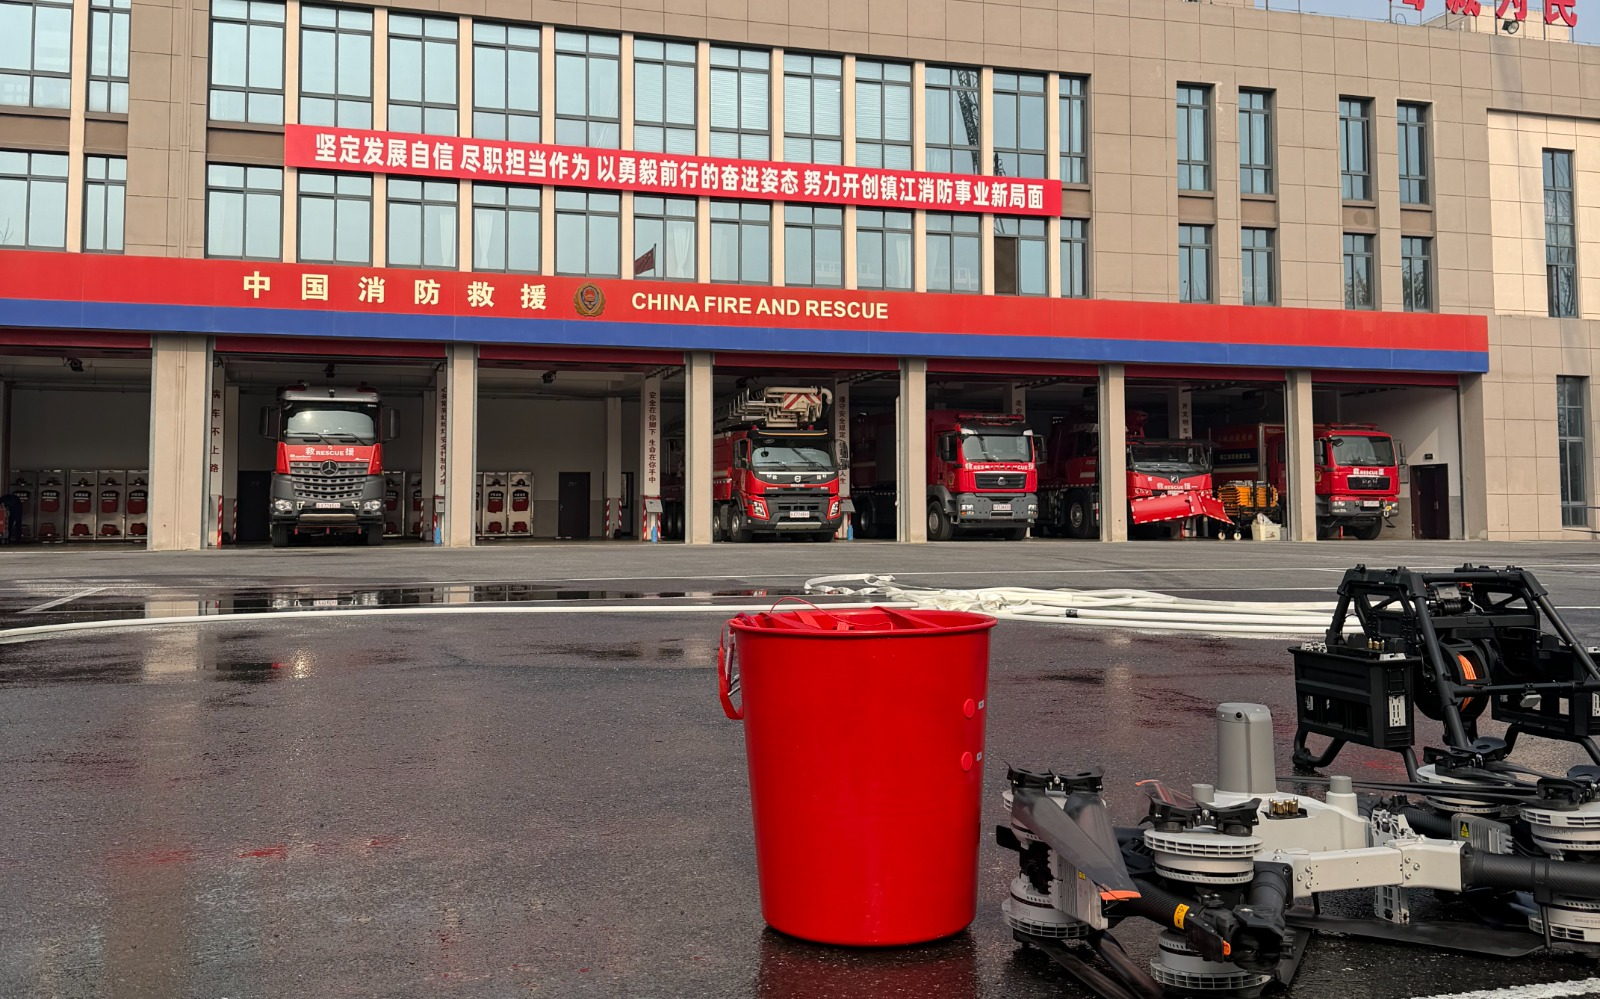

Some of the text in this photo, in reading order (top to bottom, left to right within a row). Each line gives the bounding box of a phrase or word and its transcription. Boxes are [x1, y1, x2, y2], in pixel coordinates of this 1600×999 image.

[314, 133, 1044, 210] 坚定发展自信 尽职担当作为 以勇毅前行的奋进姿态 努力开创镇江消防事业新局面
[243, 270, 547, 310] 中国消防救援
[631, 292, 889, 320] CHINA FIRE AND RESCUE
[648, 439, 657, 484] 生命在你手中
